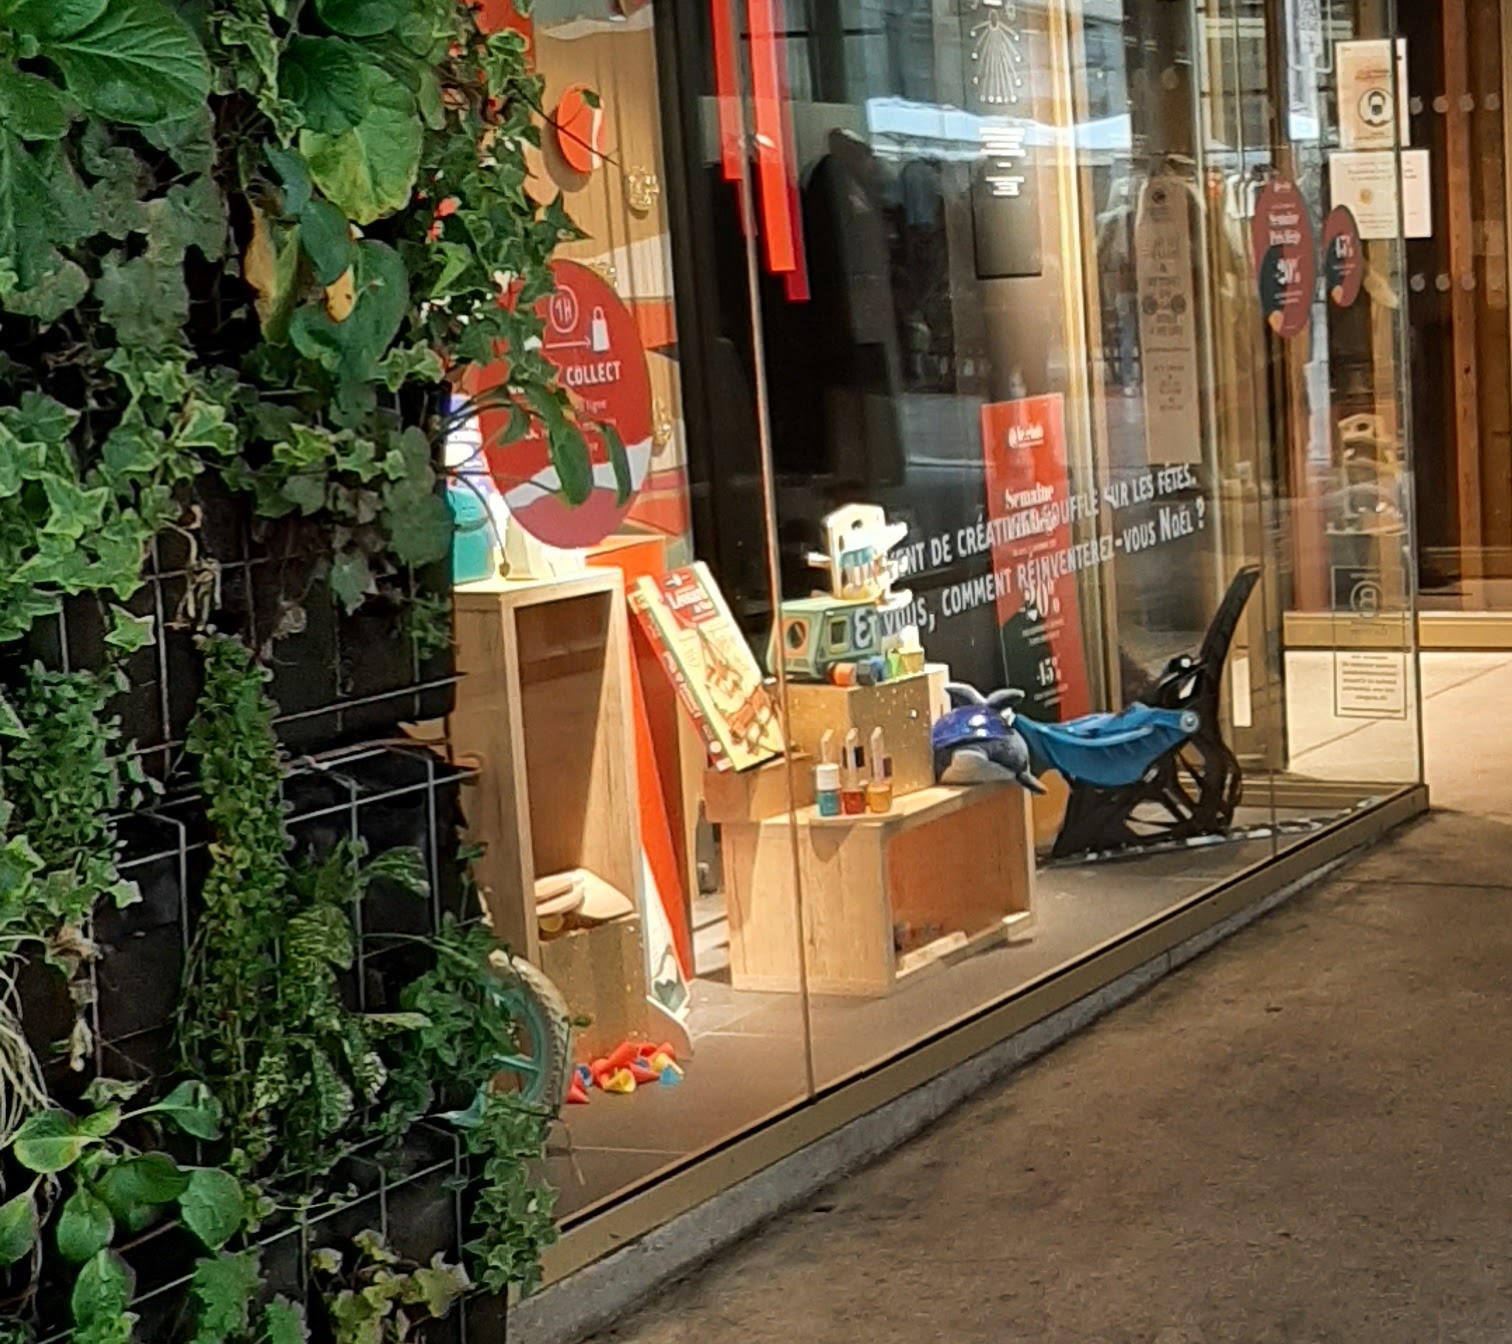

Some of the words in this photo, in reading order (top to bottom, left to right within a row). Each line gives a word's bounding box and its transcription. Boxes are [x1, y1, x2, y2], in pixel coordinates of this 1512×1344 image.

[566, 361, 622, 386] COLLECT
[931, 534, 952, 568] DE
[1132, 474, 1154, 503] LES
[941, 567, 1012, 618] COMMENT
[1195, 495, 1206, 530] ?
